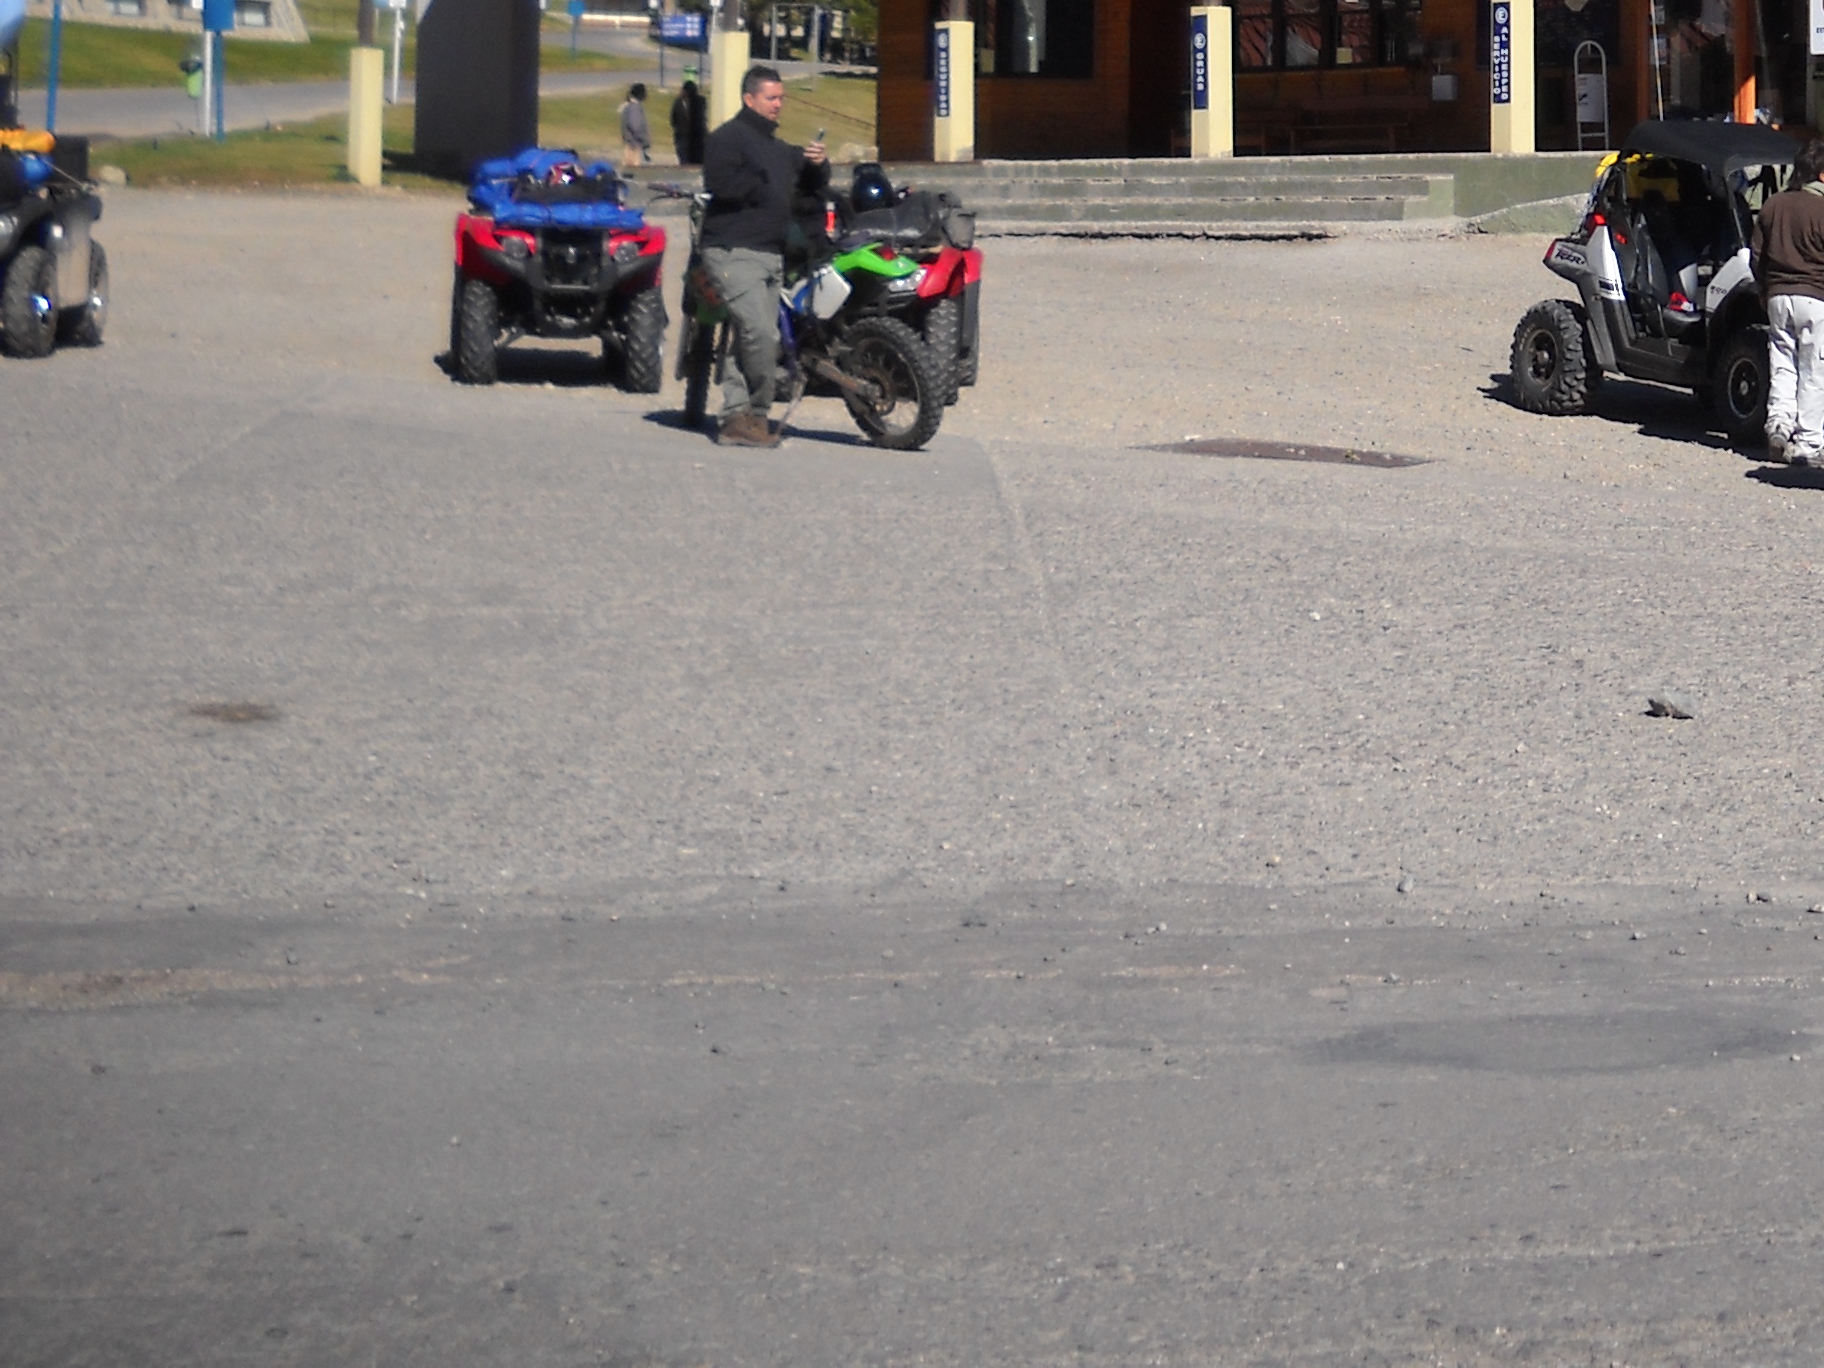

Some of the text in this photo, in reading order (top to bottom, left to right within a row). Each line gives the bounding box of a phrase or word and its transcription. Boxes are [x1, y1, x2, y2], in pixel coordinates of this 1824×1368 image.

[1196, 52, 1204, 91] GRUAS
[1493, 35, 1501, 95] SERVICIO
[1501, 26, 1509, 100] AL HUESPED
